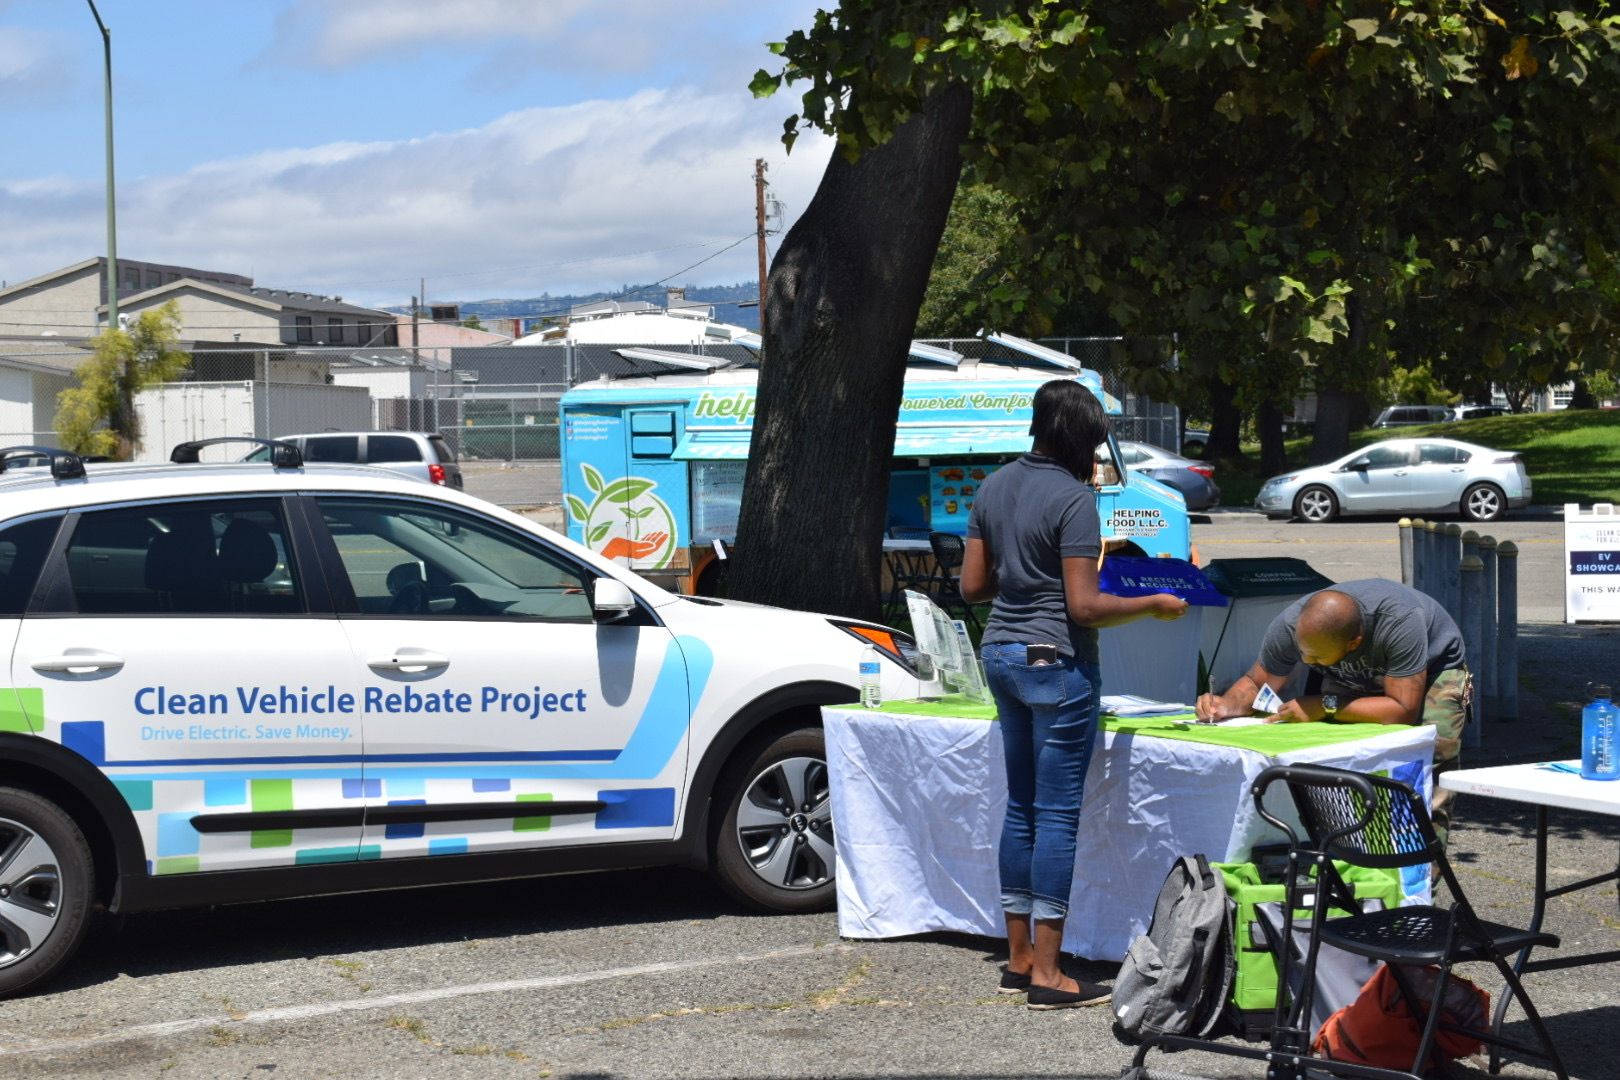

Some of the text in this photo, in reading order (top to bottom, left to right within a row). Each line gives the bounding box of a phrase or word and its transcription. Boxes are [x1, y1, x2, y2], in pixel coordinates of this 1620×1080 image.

[902, 394, 967, 410] owered
[1113, 509, 1160, 518] HELPING
[1106, 519, 1168, 528] FOOD L.L.C.
[1598, 553, 1611, 561] EV
[1140, 576, 1185, 584] RECYCLE
[1139, 582, 1195, 590] RECICLAJE
[134, 685, 587, 720] Clean Vehicle Rebate Project
[141, 725, 353, 741] Drive Electric. Save Money.
